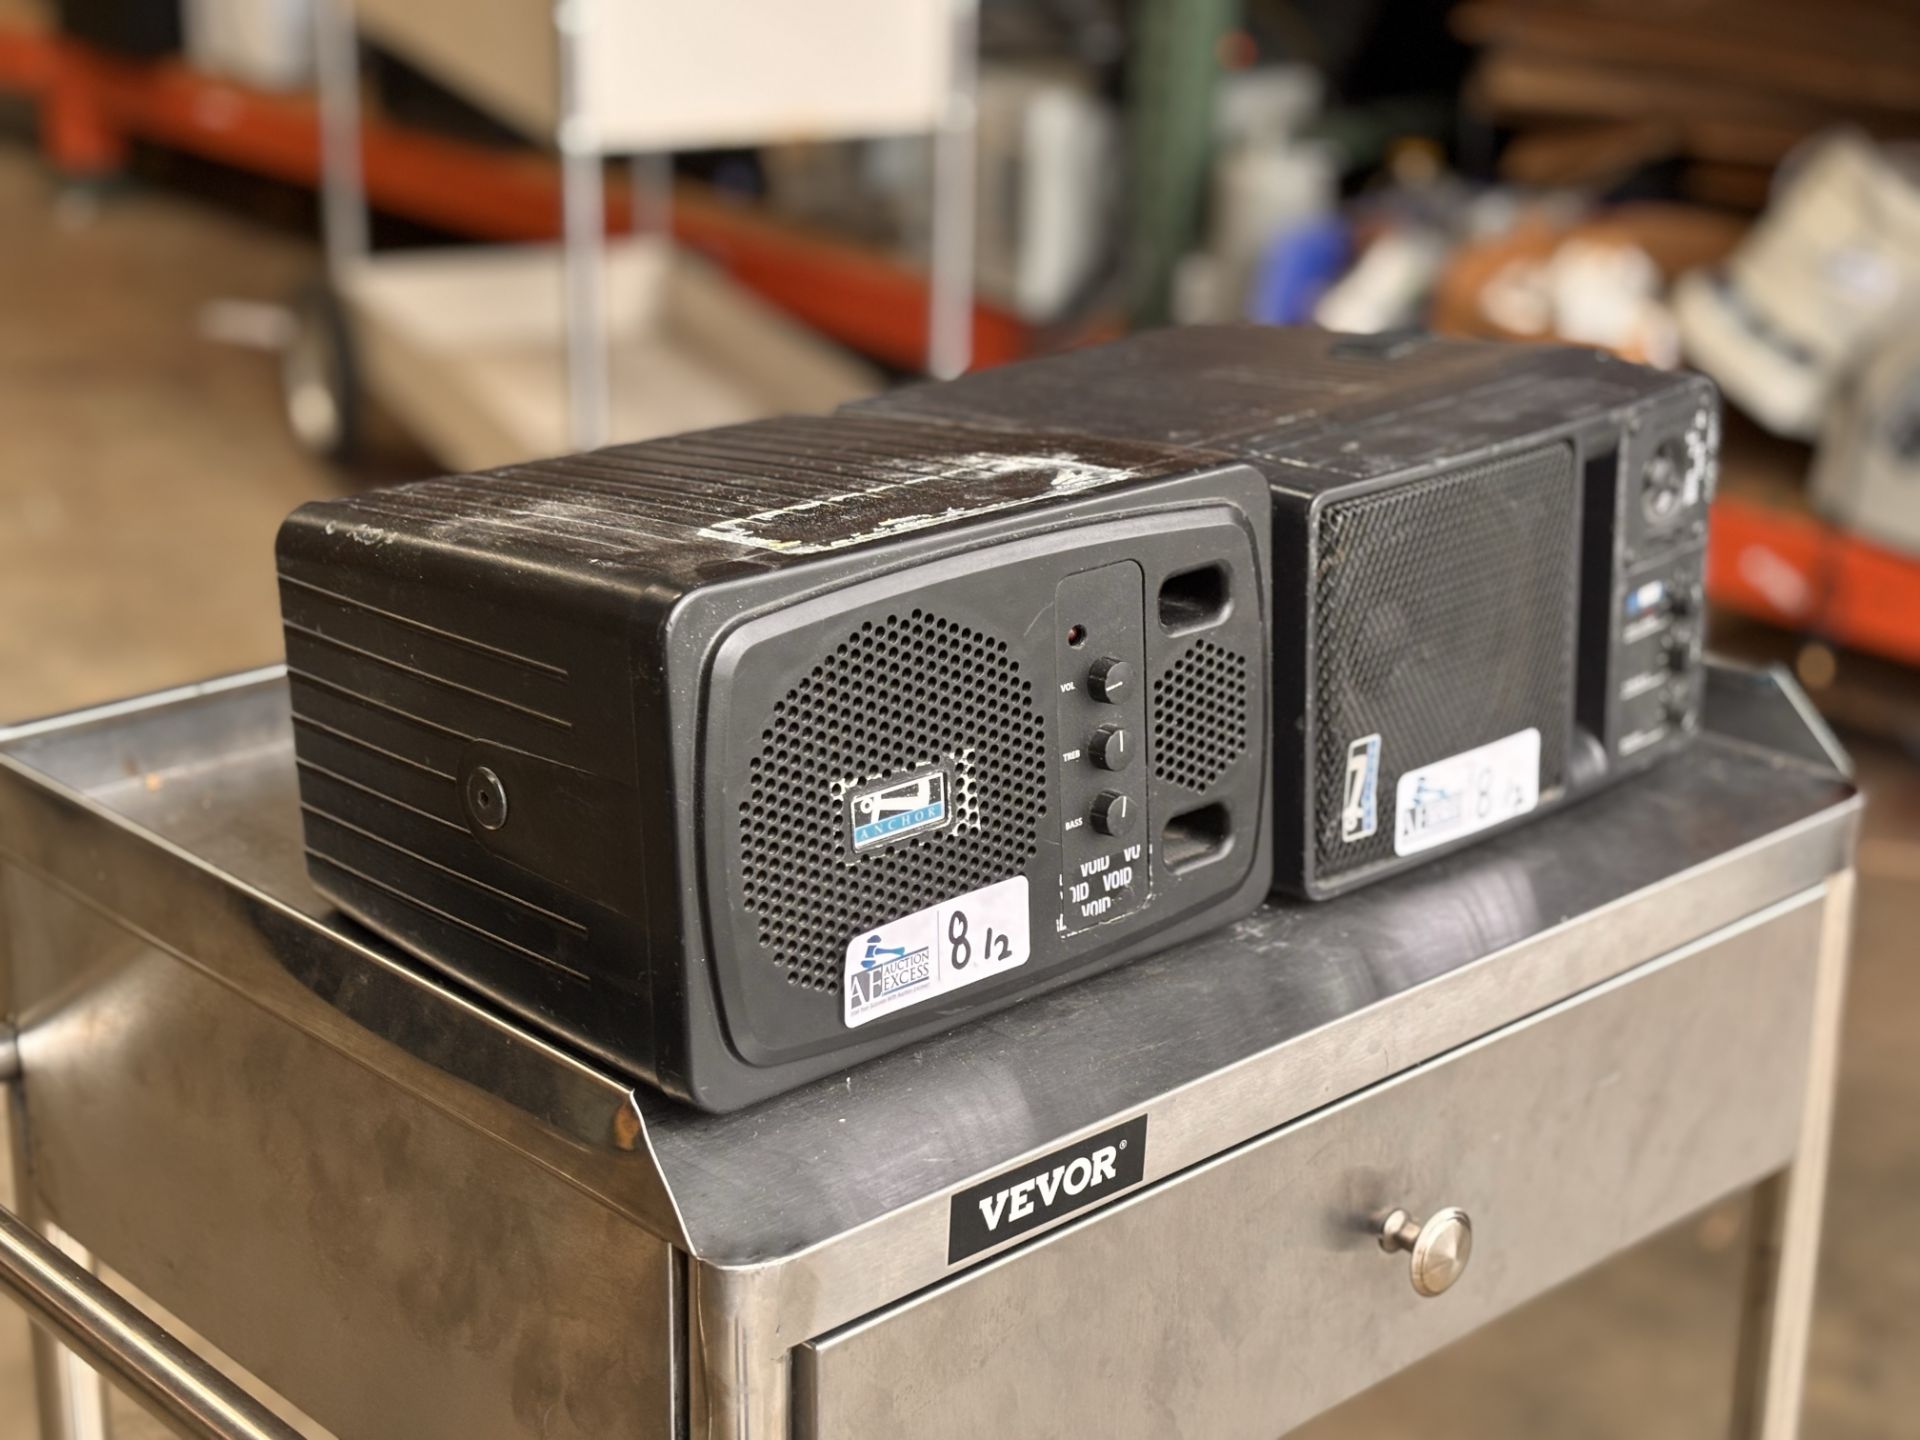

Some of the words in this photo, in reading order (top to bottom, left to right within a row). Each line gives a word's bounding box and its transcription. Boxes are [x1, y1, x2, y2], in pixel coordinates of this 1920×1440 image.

[1060, 681, 1076, 693] VOL
[1062, 749, 1081, 762] TREB
[859, 806, 937, 841] ANCHOR
[1065, 817, 1083, 831] BASS
[1102, 866, 1132, 892] VOID
[948, 910, 971, 970] 8
[984, 927, 1013, 961] 12
[884, 950, 930, 976] AUCTION
[884, 962, 930, 992] EXCESS
